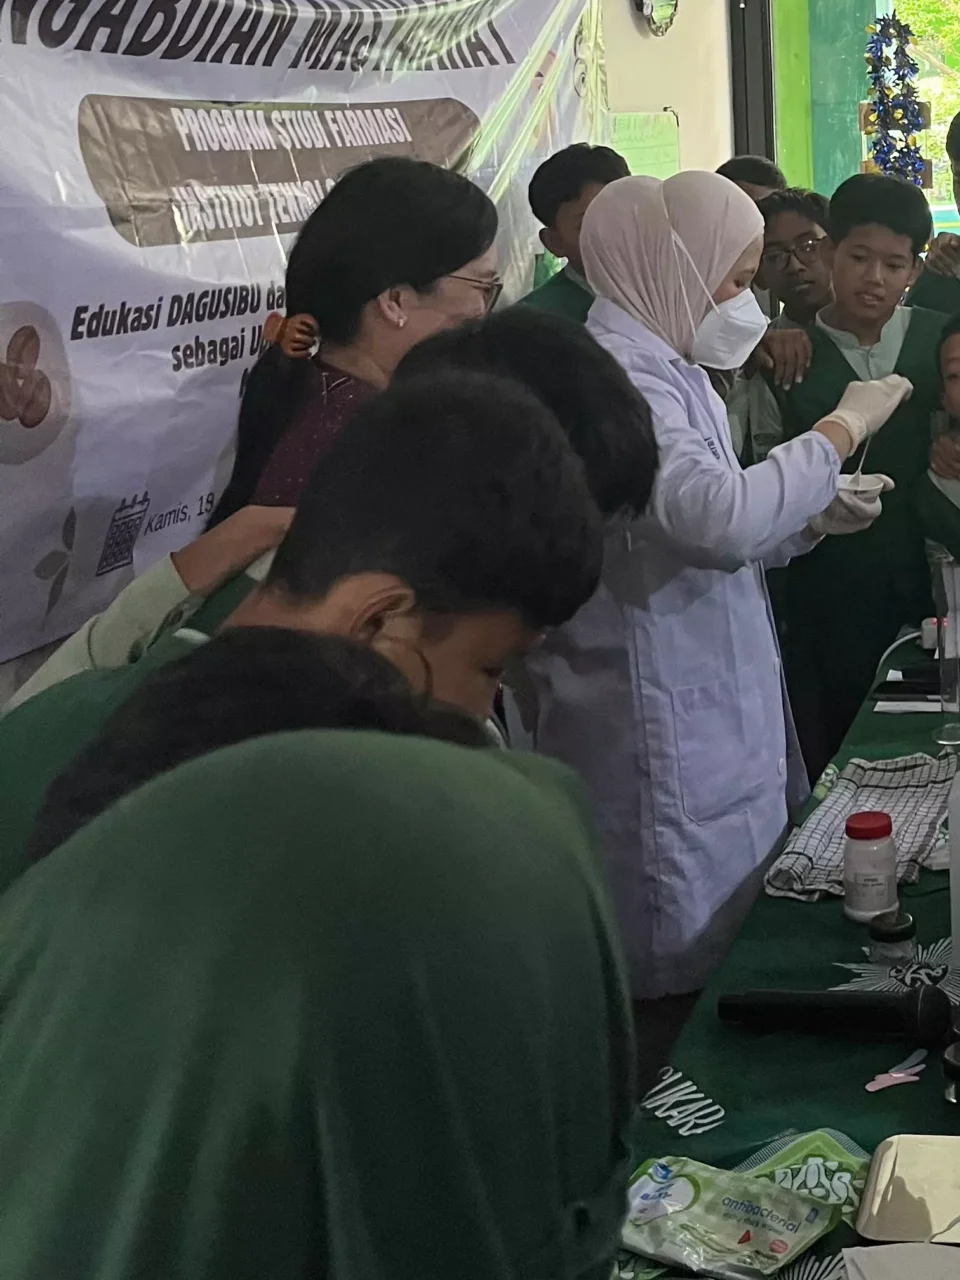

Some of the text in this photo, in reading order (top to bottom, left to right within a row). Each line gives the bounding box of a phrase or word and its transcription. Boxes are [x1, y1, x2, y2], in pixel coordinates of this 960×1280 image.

[171, 107, 412, 151] PROGRAM STUDI FARMASI
[171, 184, 264, 232] INSTITUT
[70, 297, 164, 341] Edukasi
[166, 282, 261, 328] DAGUSIBU
[171, 327, 245, 372] sebagai
[144, 501, 191, 536] Kamis,
[722, 1196, 802, 1234] antibacterial
